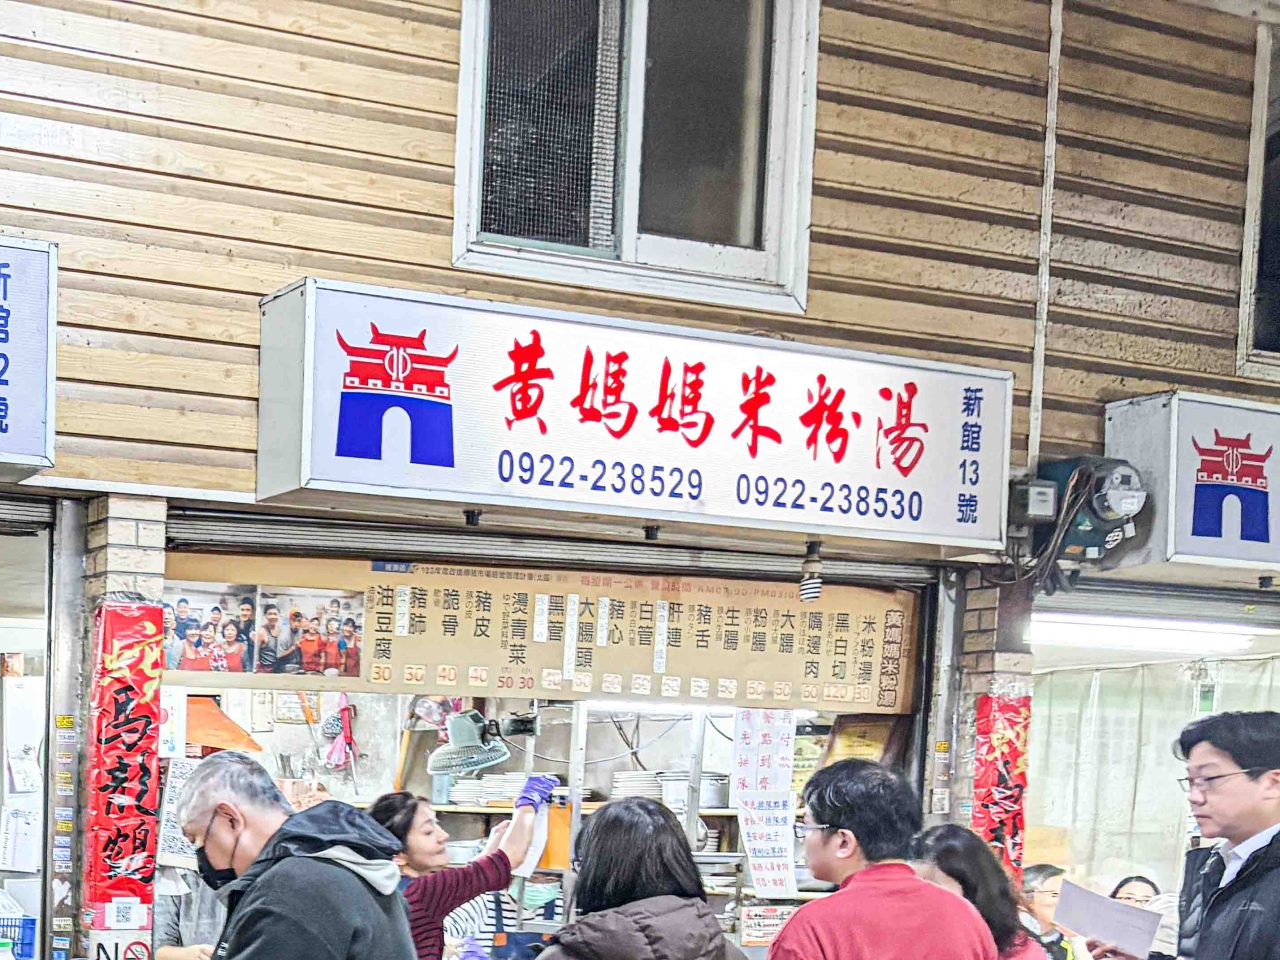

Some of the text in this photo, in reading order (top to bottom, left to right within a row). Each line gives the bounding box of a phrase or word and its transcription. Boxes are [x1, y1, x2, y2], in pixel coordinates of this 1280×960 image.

[956, 386, 984, 524] 新館13號
[497, 449, 923, 522] 0922-238529 0922-238530
[374, 585, 395, 660] 油豆腐
[575, 596, 595, 668] 大腸頭
[637, 600, 654, 646] 白管
[373, 665, 392, 682] 30
[497, 676, 513, 689] 50
[519, 676, 535, 690] 30
